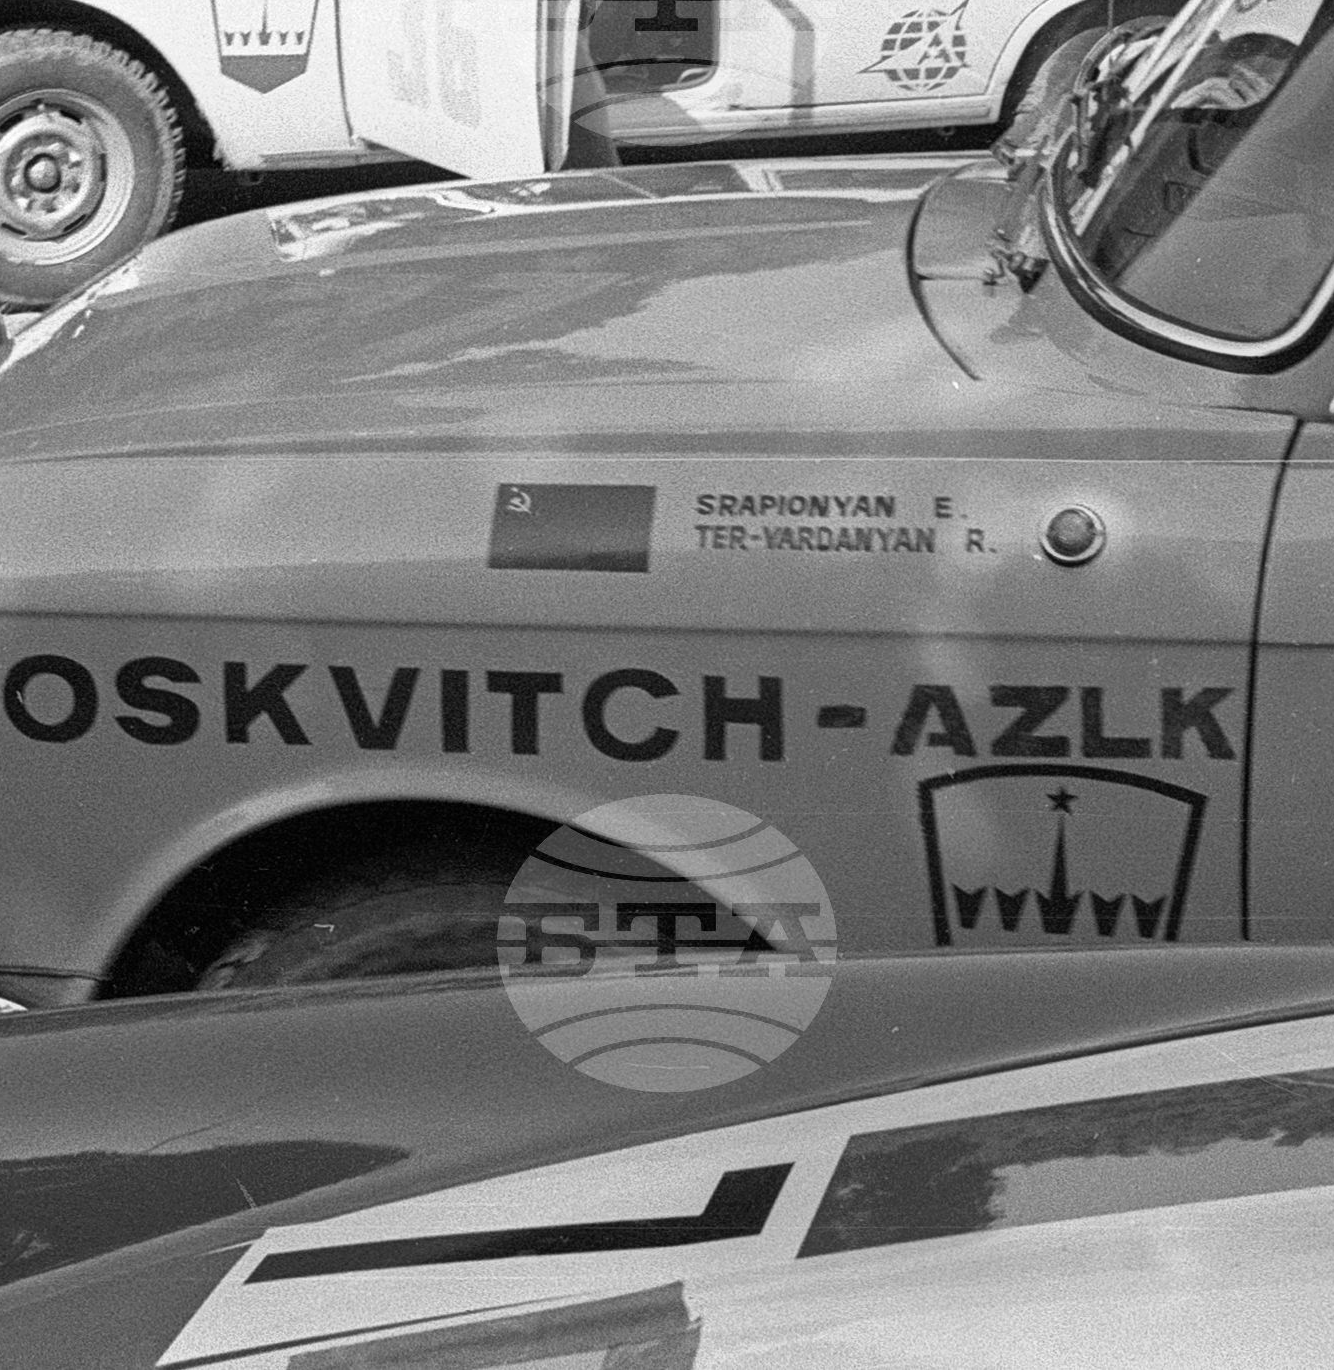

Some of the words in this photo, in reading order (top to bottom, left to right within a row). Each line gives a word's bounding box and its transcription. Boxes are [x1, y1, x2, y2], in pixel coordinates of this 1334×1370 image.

[695, 493, 896, 518] SRAPIONYAN
[934, 496, 967, 519] E.
[967, 528, 997, 553] R.
